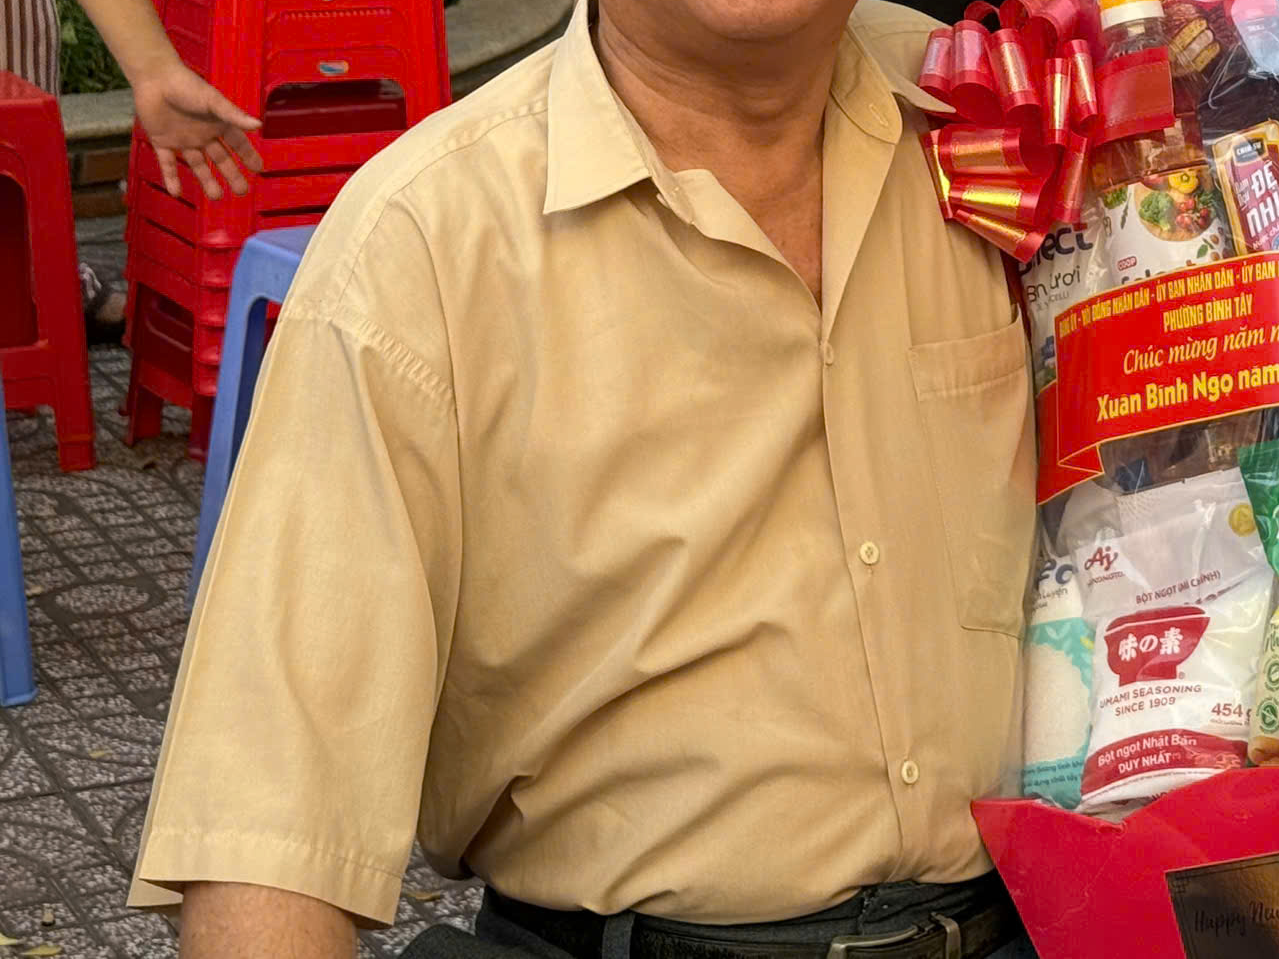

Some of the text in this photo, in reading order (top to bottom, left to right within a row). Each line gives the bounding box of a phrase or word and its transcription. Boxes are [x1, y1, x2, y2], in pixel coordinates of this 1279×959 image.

[1168, 279, 1185, 298] BAN
[1186, 271, 1213, 295] NHÂN
[1214, 267, 1235, 290] DÂN
[1241, 261, 1253, 284] ỦY
[1255, 260, 1276, 281] BAN
[1163, 292, 1253, 333] PHƯỜNG BÌNH TÂY
[1123, 345, 1164, 375] Chúc
[1168, 336, 1218, 366] mừng
[1223, 326, 1265, 353] năm
[1096, 391, 1142, 423] Xuân
[1145, 377, 1188, 409] Bính
[1192, 370, 1234, 402] Ngọ
[1118, 627, 1183, 661] 味の素
[1100, 685, 1202, 709] UMAMI SEASONING
[1115, 697, 1176, 717] SINCE 1909
[1211, 702, 1244, 717] 454
[1098, 751, 1117, 767] Bột
[1117, 742, 1141, 761] ngọt
[1142, 734, 1169, 752] Nhật
[1118, 748, 1172, 774] DUY NHẤT
[1194, 910, 1247, 937] Happy
